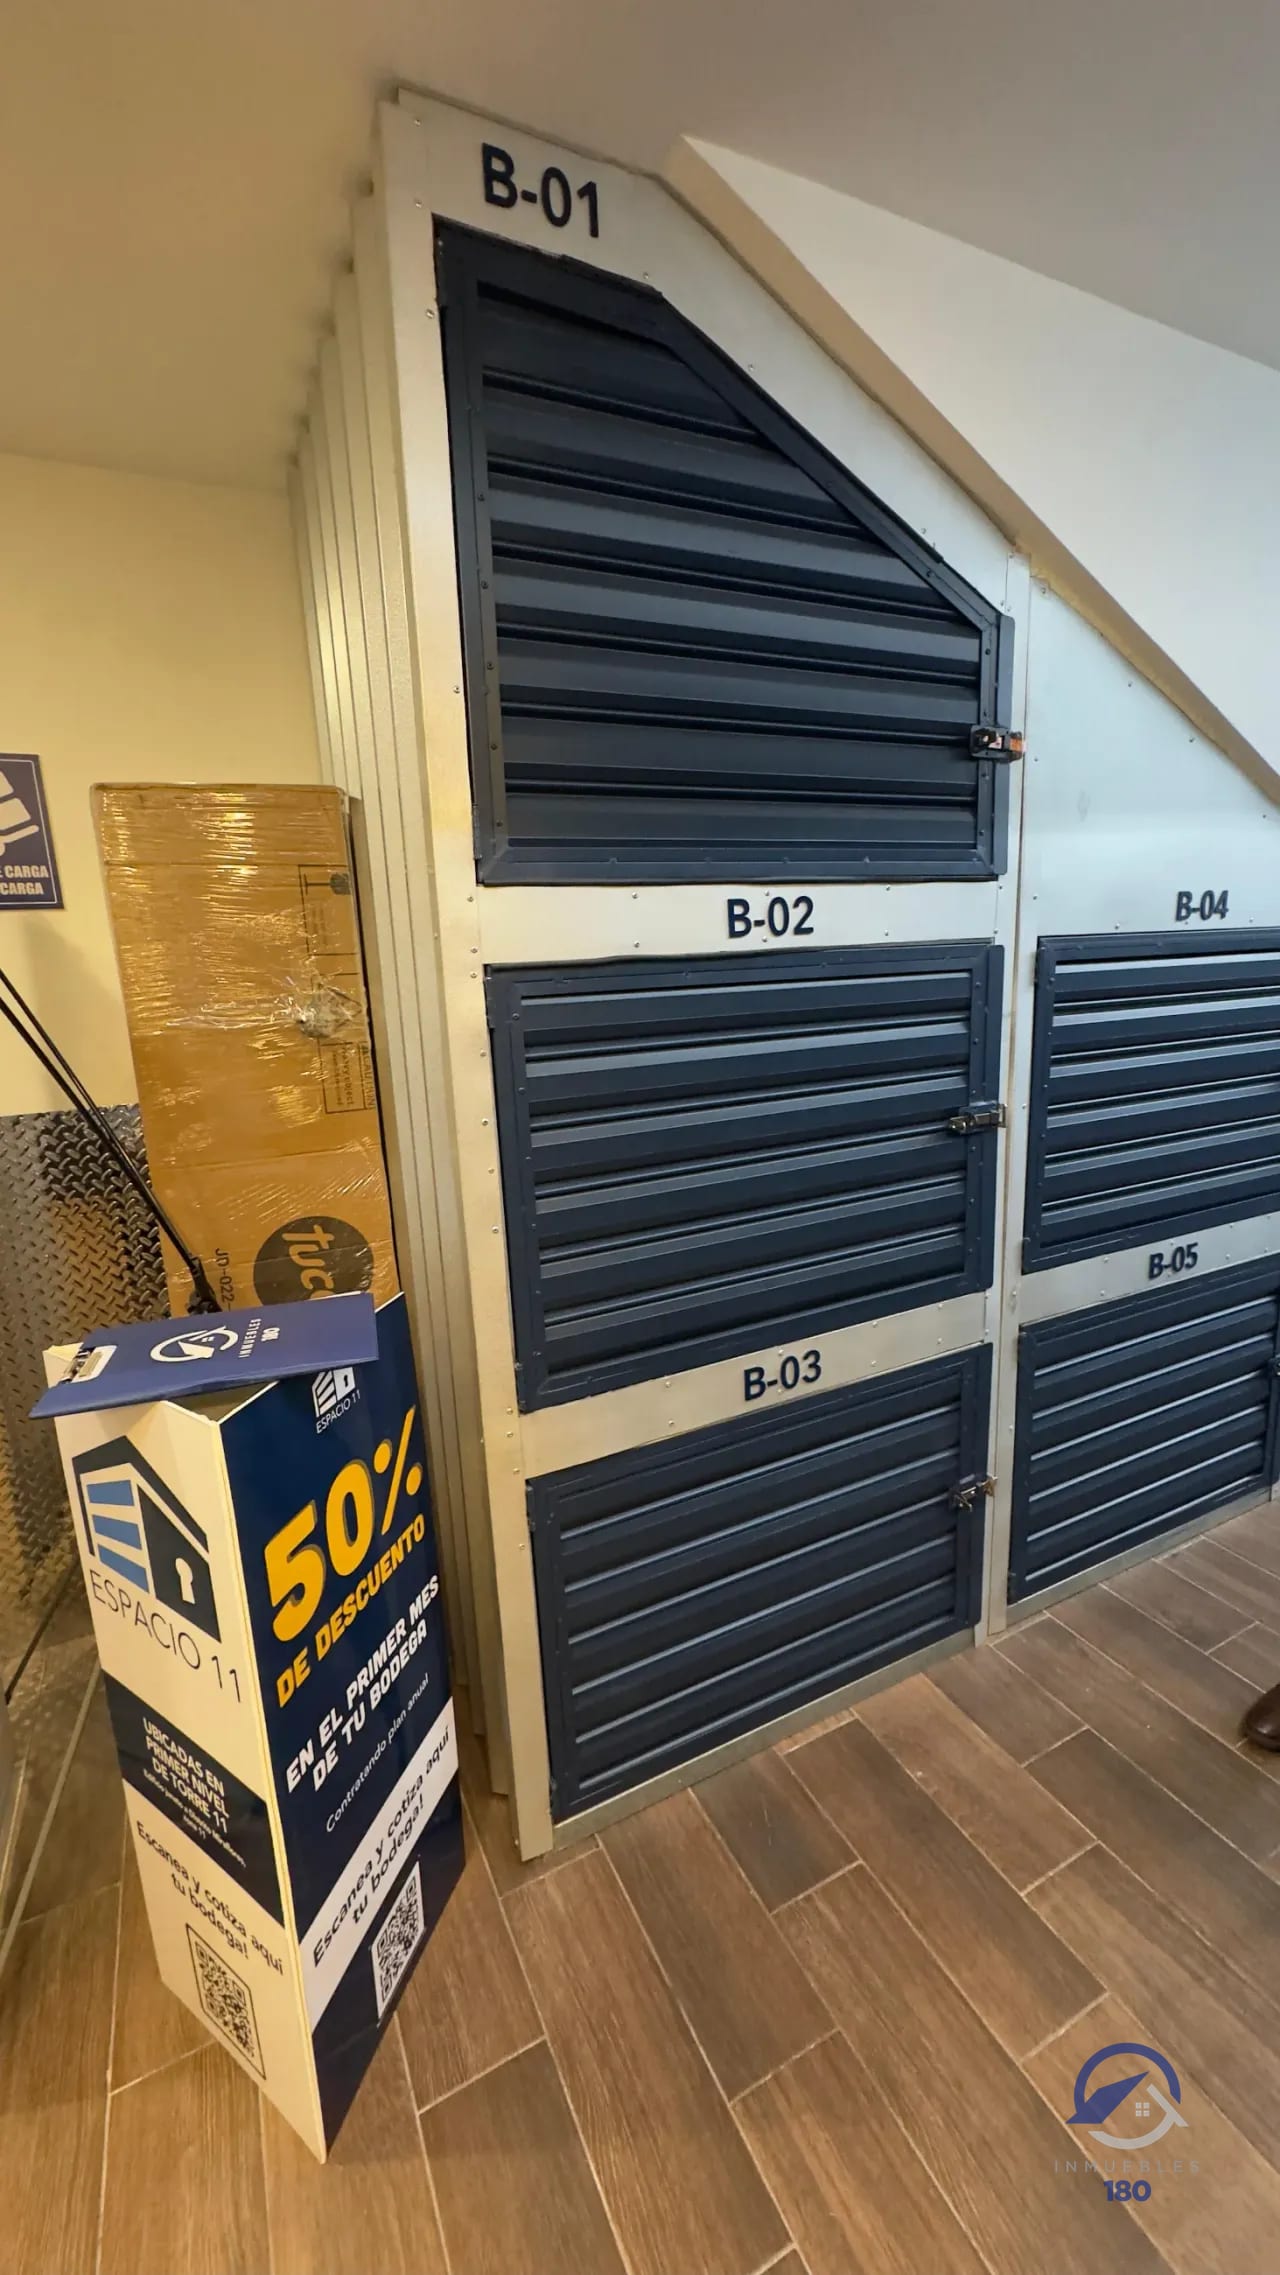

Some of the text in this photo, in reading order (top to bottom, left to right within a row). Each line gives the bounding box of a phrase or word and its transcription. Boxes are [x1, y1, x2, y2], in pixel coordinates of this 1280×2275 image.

[482, 142, 599, 238] B-01
[4, 865, 49, 878] CARGA
[727, 895, 814, 939] B-02
[1175, 890, 1229, 921] B-04
[1148, 1241, 1198, 1280] B-05
[316, 1389, 361, 1434] ESPACIO 11
[744, 1350, 822, 1402] B-03
[264, 1405, 423, 1641] 50%
[90, 1569, 240, 1703] ESPACIO 11
[276, 1513, 425, 1709] DE DESCUENTO
[286, 1574, 440, 1793] EN EL PRIMER MES
[312, 1617, 428, 1792] DE TU BODEGA
[143, 1717, 225, 1797] UBICADAS EN
[145, 1735, 190, 1783] PRIMER
[192, 1774, 230, 1818] NIVEL
[152, 1757, 170, 1782] DE
[170, 1775, 211, 1819] TORRE
[213, 1810, 228, 1834] 11
[326, 1672, 429, 1833] Contratando plan anual
[136, 1820, 189, 1881] Escanea
[192, 1876, 200, 1895] y
[204, 1889, 247, 1937] cotiza
[313, 1858, 373, 1968] Escanea
[375, 1836, 384, 1865] y
[387, 1774, 423, 1838] cotiza
[351, 1793, 424, 1924] tu bodega!
[171, 1873, 249, 1960] tu bodega!
